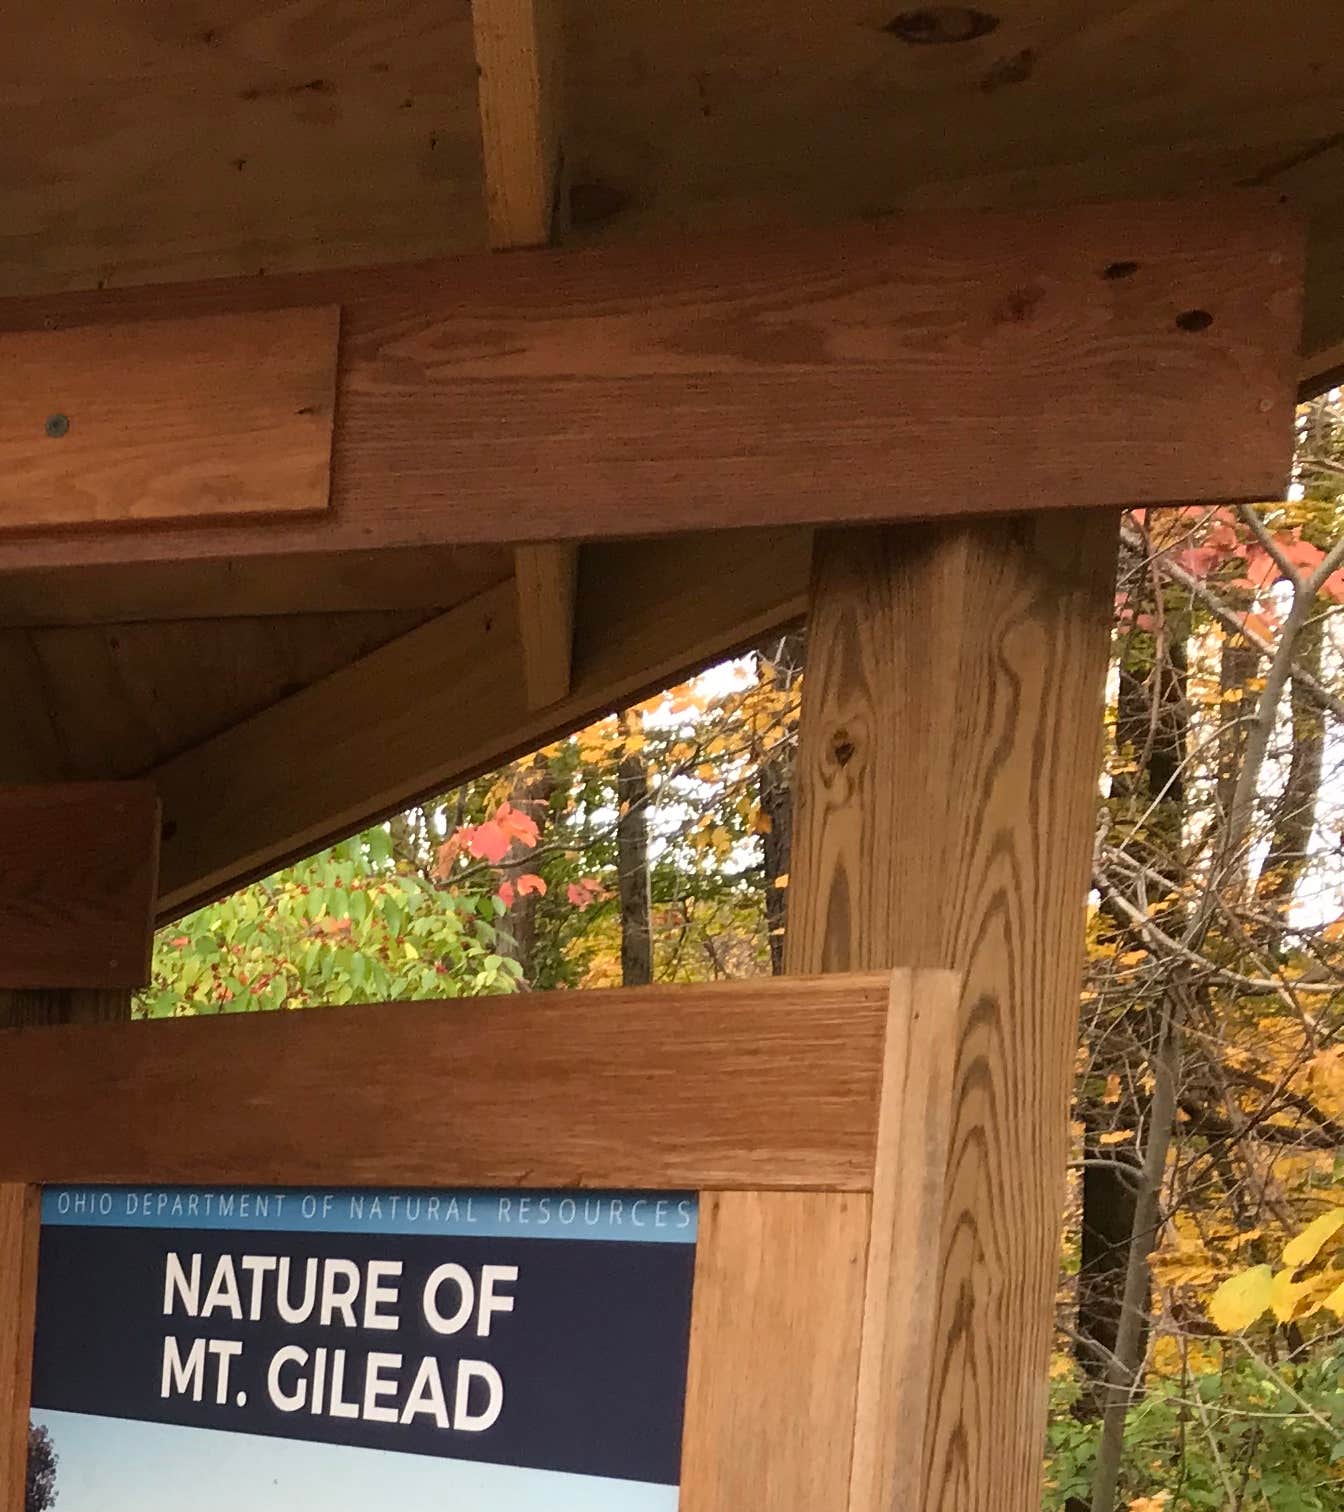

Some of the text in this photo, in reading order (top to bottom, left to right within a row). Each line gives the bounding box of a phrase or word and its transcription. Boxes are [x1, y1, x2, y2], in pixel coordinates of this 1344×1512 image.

[57, 1192, 691, 1229] OHIO DEPARTMENT OF NATURAL RESOURCES
[163, 1252, 519, 1337] NATURE OF
[160, 1335, 503, 1432] MT. GILEAD
